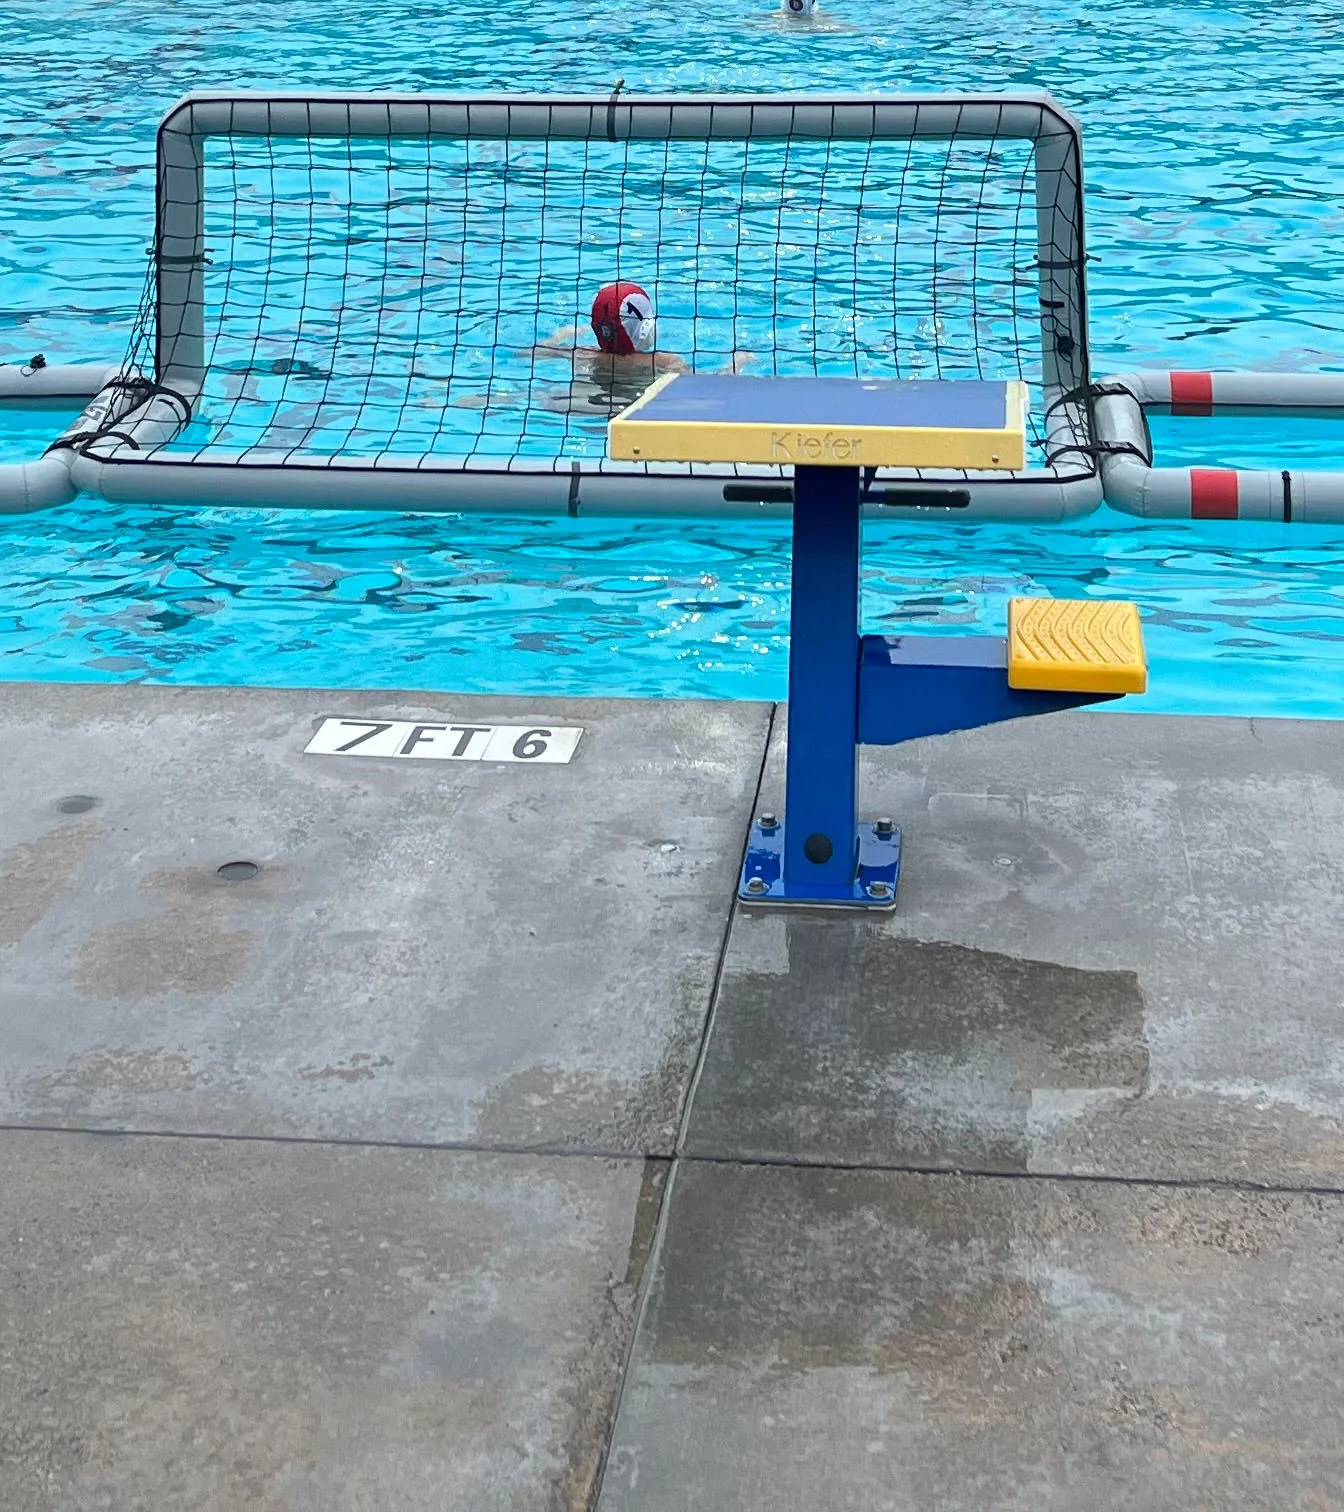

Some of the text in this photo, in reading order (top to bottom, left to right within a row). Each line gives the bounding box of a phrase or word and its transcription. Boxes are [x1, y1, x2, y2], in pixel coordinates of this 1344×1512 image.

[626, 300, 644, 322] 1
[770, 431, 863, 460] Kiefer
[333, 721, 553, 759] 7 FT 6
